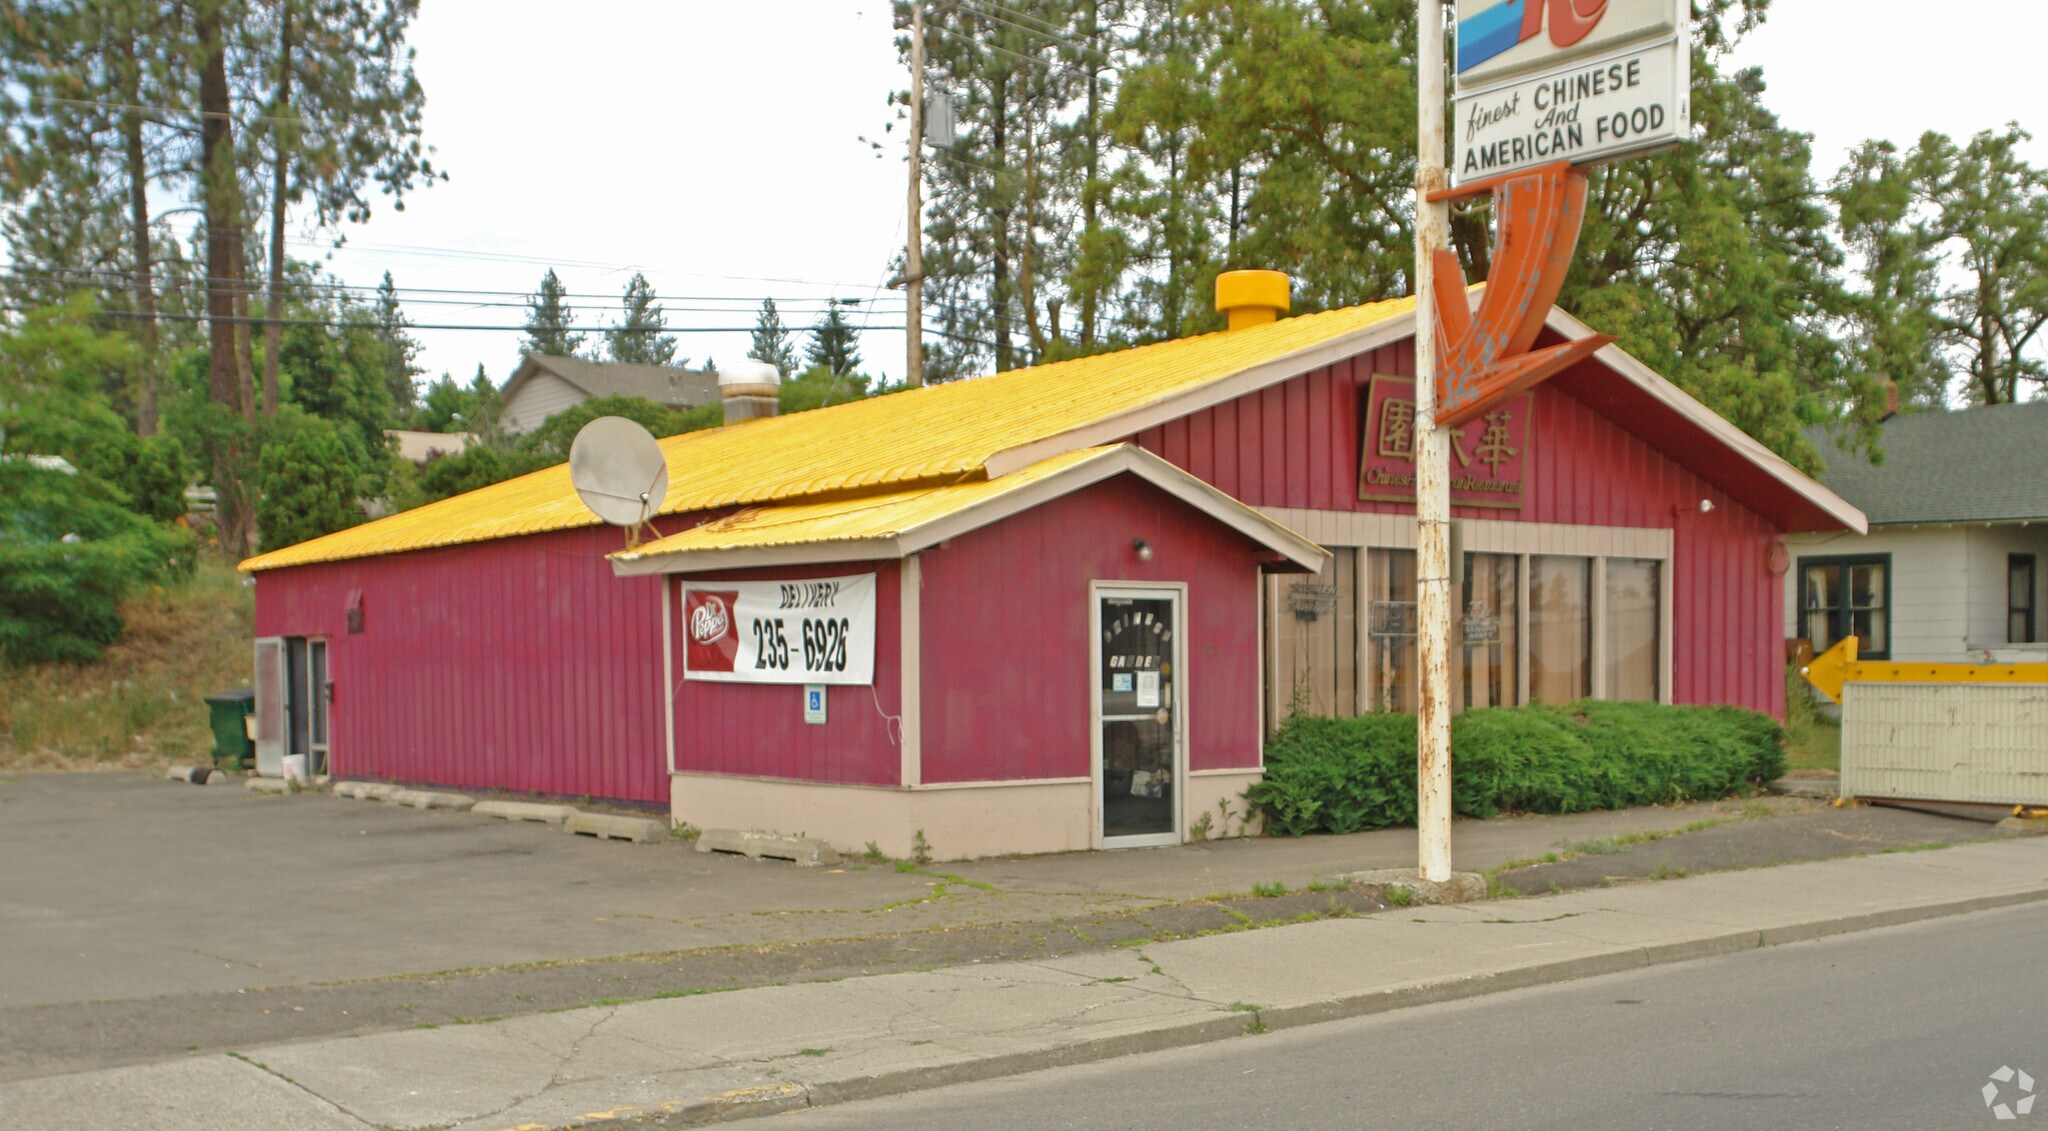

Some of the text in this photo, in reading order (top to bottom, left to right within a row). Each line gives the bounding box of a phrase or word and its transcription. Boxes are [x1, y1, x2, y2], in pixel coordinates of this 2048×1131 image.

[1466, 91, 1521, 142] finest
[1534, 58, 1641, 110] CHINESE
[1535, 102, 1581, 130] And
[1464, 122, 1584, 173] AMERICAN
[1597, 103, 1665, 143] FOOD
[705, 601, 717, 620] Dr
[779, 581, 840, 609] DELIVERY
[694, 605, 725, 640] Pepper
[753, 617, 849, 672] 235-6926
